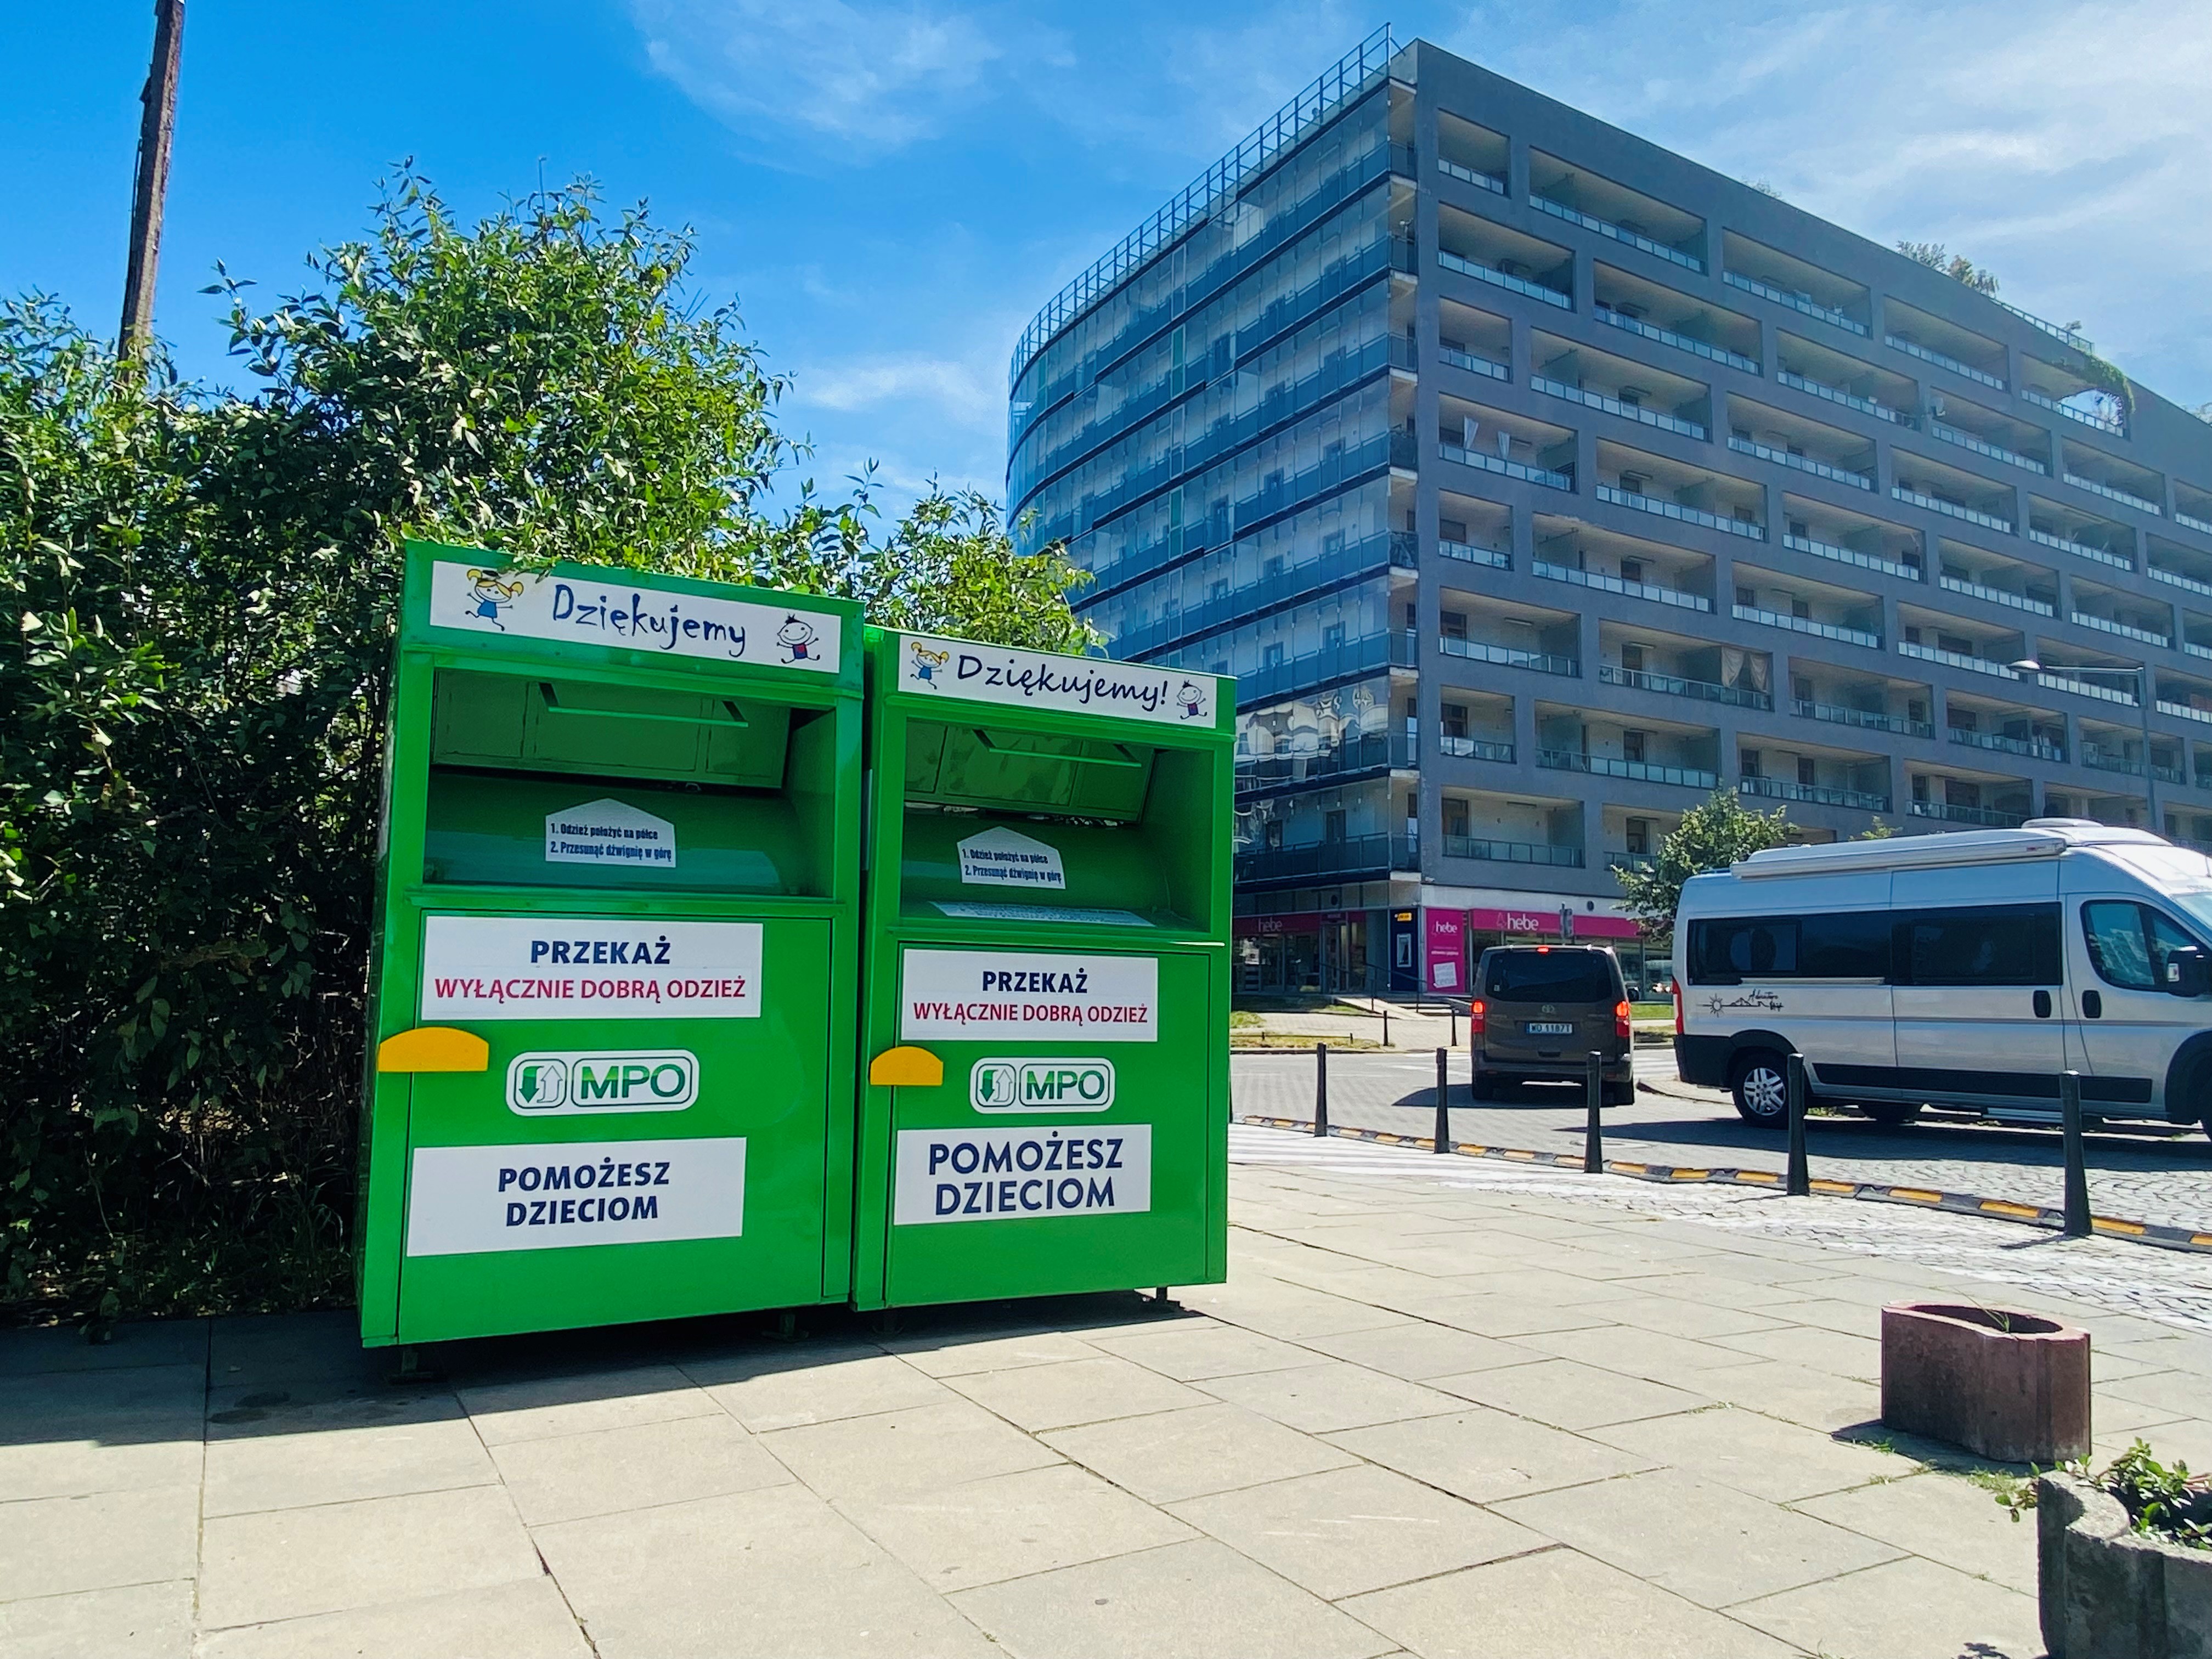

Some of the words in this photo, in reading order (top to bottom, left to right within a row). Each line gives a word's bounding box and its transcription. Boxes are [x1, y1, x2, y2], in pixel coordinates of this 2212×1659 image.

[551, 584, 747, 658] Dziękujemy
[957, 654, 1169, 712] Dziękujemy!
[550, 823, 559, 834] 1.
[590, 826, 622, 839] położyć
[624, 830, 634, 839] na
[636, 828, 658, 840] półce
[550, 841, 558, 853] 2.
[561, 842, 604, 859] Przesunąć
[645, 848, 652, 858] w
[654, 847, 672, 862] górę
[1259, 916, 1283, 933] hebe
[1435, 921, 1458, 933] hebe
[1507, 912, 1539, 931] hebe
[530, 935, 670, 964] PRZEKAŻ
[435, 979, 574, 1004] WYŁĄCZNIE
[580, 980, 661, 1003] DOBRĄ
[667, 975, 746, 998] ODZIEŻ
[982, 968, 1088, 994] PRZEKAŻ
[913, 1002, 1018, 1025] WYŁĄCZNIE
[1023, 1005, 1083, 1026] DOBRĄ
[1087, 1003, 1148, 1023] ODZIEŻ
[580, 1064, 686, 1099] MPO
[1026, 1070, 1105, 1100] MPO
[928, 1130, 1124, 1176] POMOŻESZ
[498, 1157, 670, 1192] POMOŻESZ
[935, 1176, 1115, 1216] DZIECIOM
[506, 1195, 658, 1227] DZIECIOM
